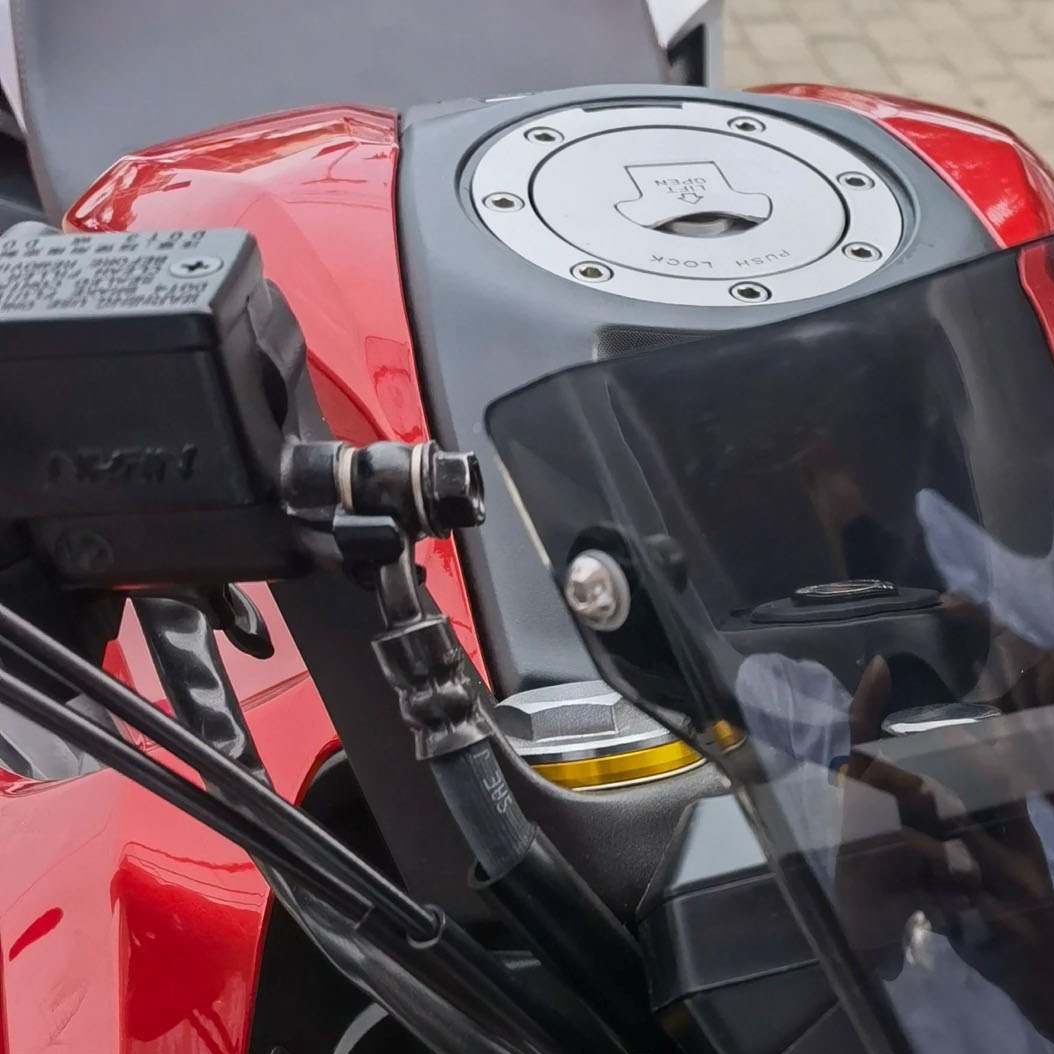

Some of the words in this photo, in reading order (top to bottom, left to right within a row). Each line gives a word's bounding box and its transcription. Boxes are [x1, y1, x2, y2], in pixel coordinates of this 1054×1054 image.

[654, 177, 707, 186] OPEN
[665, 185, 706, 193] LIFT
[648, 255, 713, 269] LOCK
[735, 249, 791, 267] PUSH
[483, 770, 515, 814] SAE
